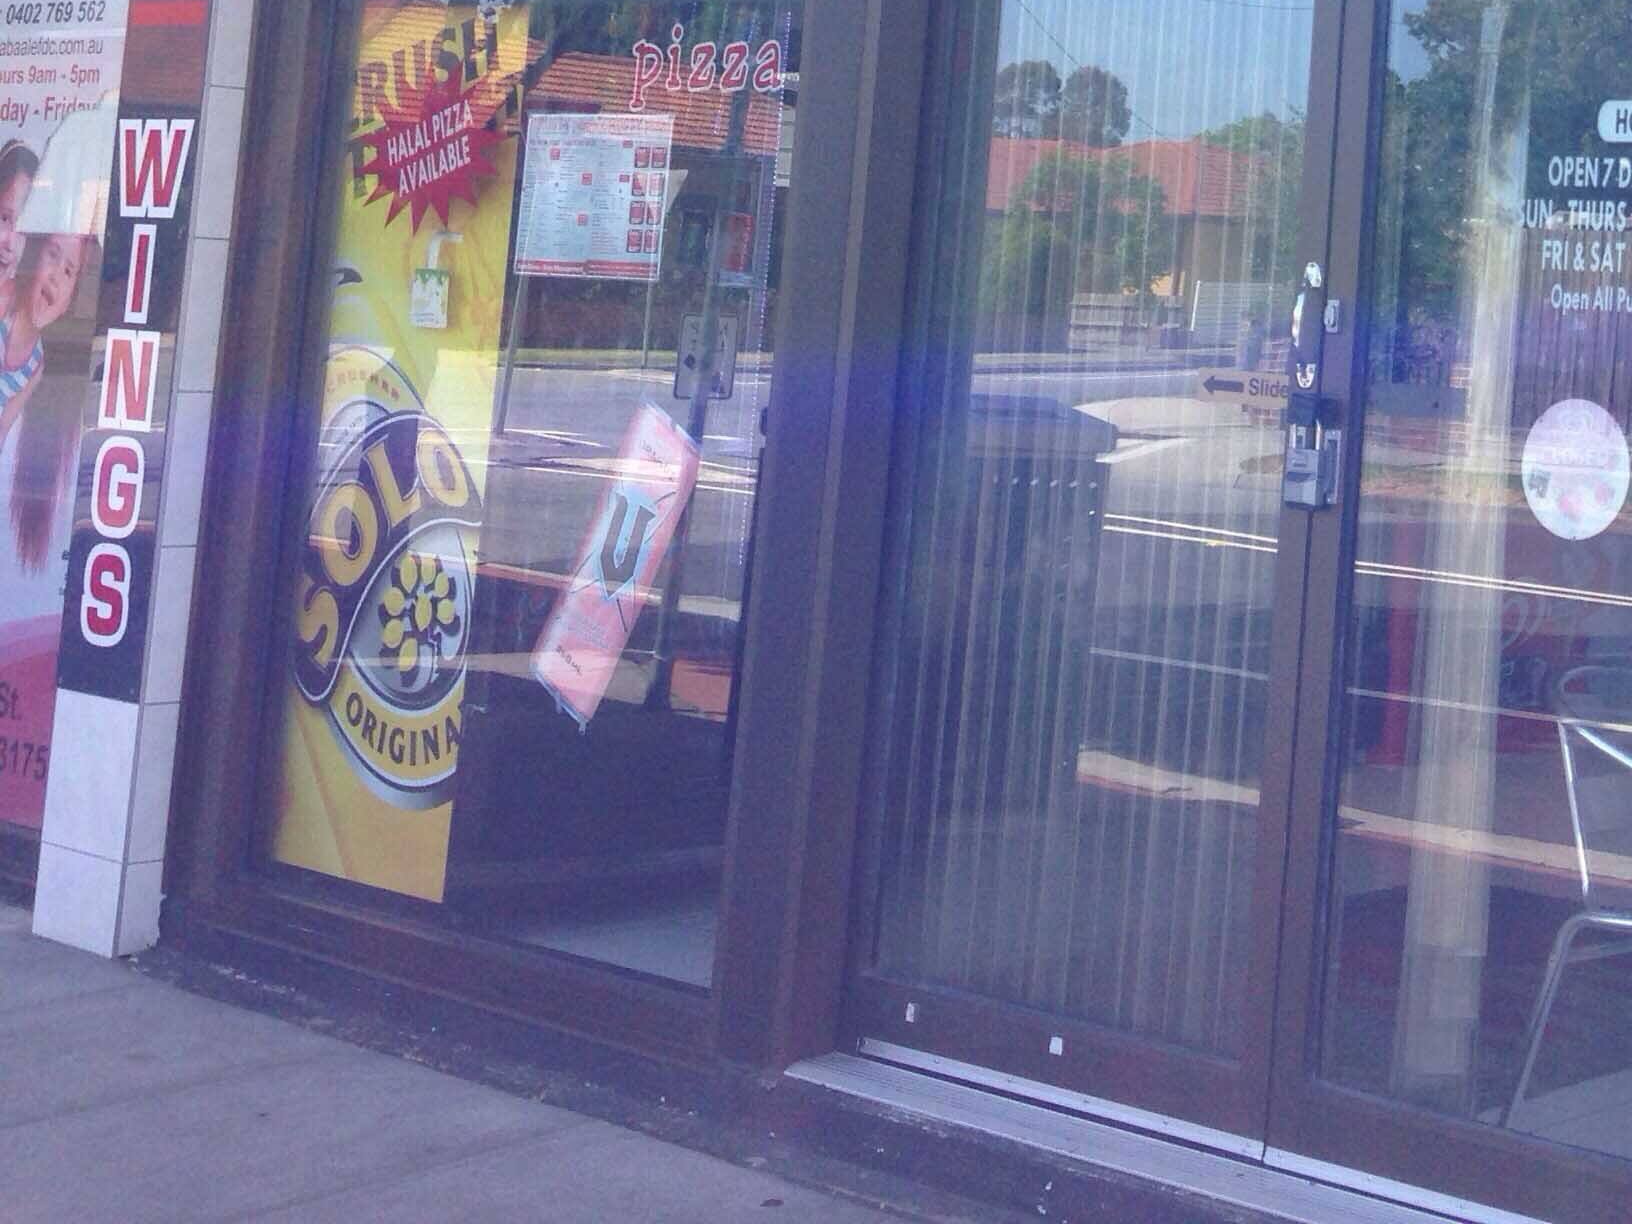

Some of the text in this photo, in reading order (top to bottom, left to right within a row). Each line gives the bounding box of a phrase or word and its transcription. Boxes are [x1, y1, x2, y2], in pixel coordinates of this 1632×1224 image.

[6, 0, 106, 25] 0402 769 562
[0, 69, 25, 85] urs
[28, 64, 58, 85] 9am
[70, 63, 100, 88] 5pm
[628, 23, 784, 112] pizza
[387, 119, 432, 167] HALAL
[432, 100, 474, 143] PIZZA
[399, 135, 471, 197] AVAILABLE
[1548, 157, 1600, 187] OPEN
[1601, 158, 1615, 188] 7
[1519, 199, 1553, 228] SUN
[1567, 199, 1627, 232] THURS
[1541, 239, 1570, 271] FRI
[1573, 242, 1585, 272] &
[1590, 241, 1626, 274] SAT
[1550, 286, 1589, 316] Open
[1592, 287, 1613, 312] All
[81, 118, 195, 648] WINGS
[1248, 376, 1289, 399] Slide
[300, 430, 469, 673] SOLO
